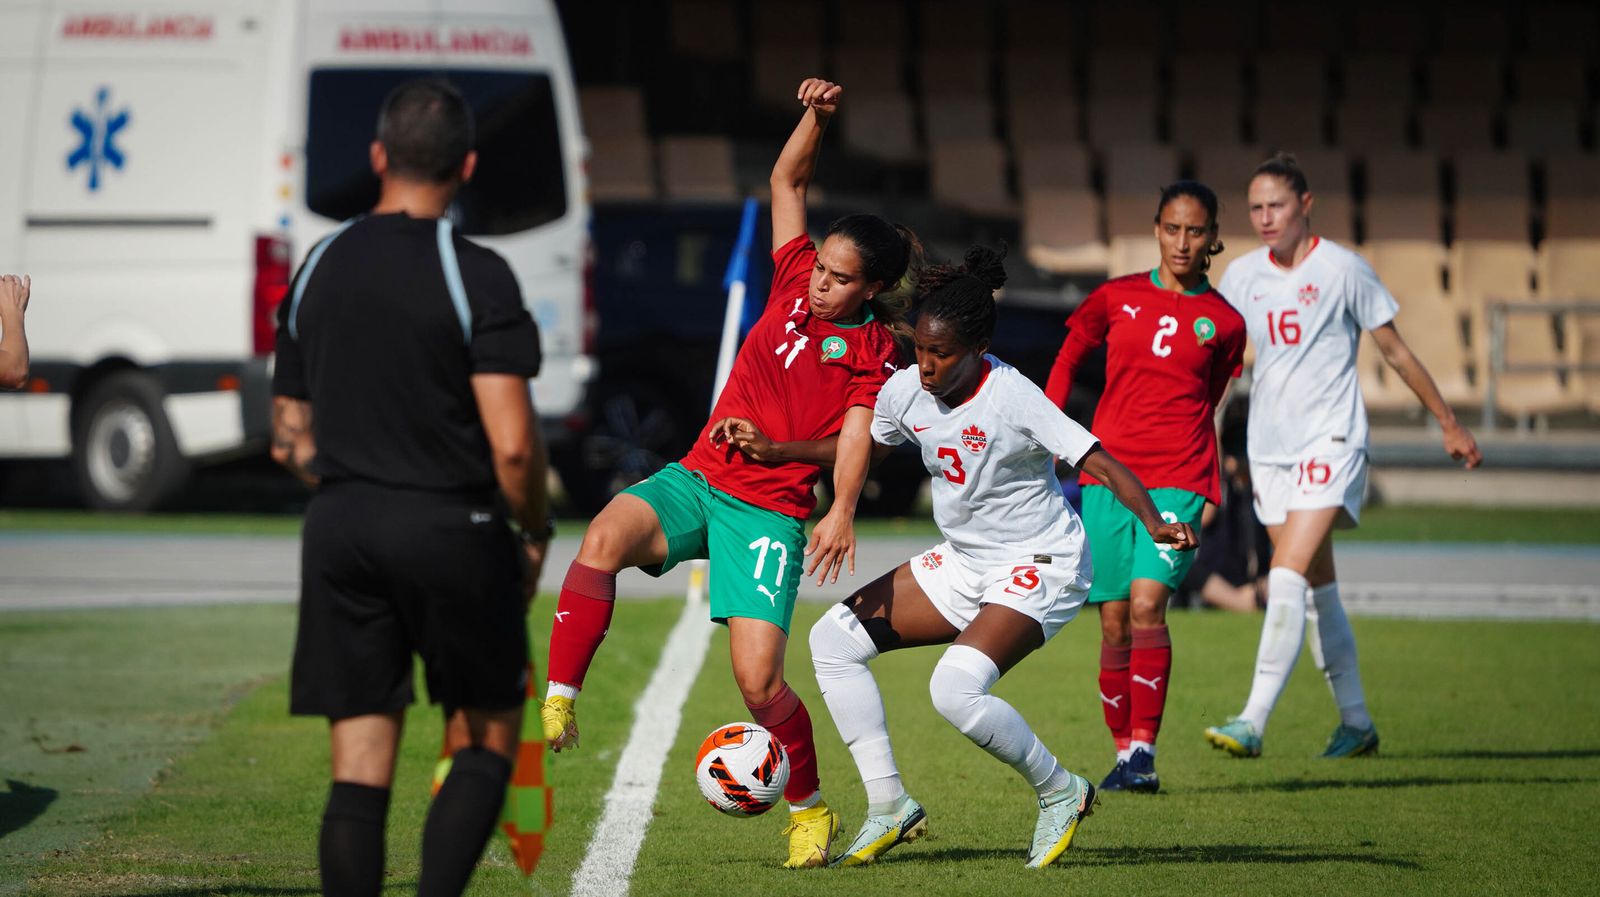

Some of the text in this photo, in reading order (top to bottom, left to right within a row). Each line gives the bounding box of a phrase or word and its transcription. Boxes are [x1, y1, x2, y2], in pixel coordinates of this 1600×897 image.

[1152, 315, 1179, 358] 2
[1267, 310, 1302, 345] 16
[937, 447, 966, 485] 3
[1297, 457, 1331, 487] 16
[748, 536, 788, 587] 17
[1010, 565, 1040, 590] 3
